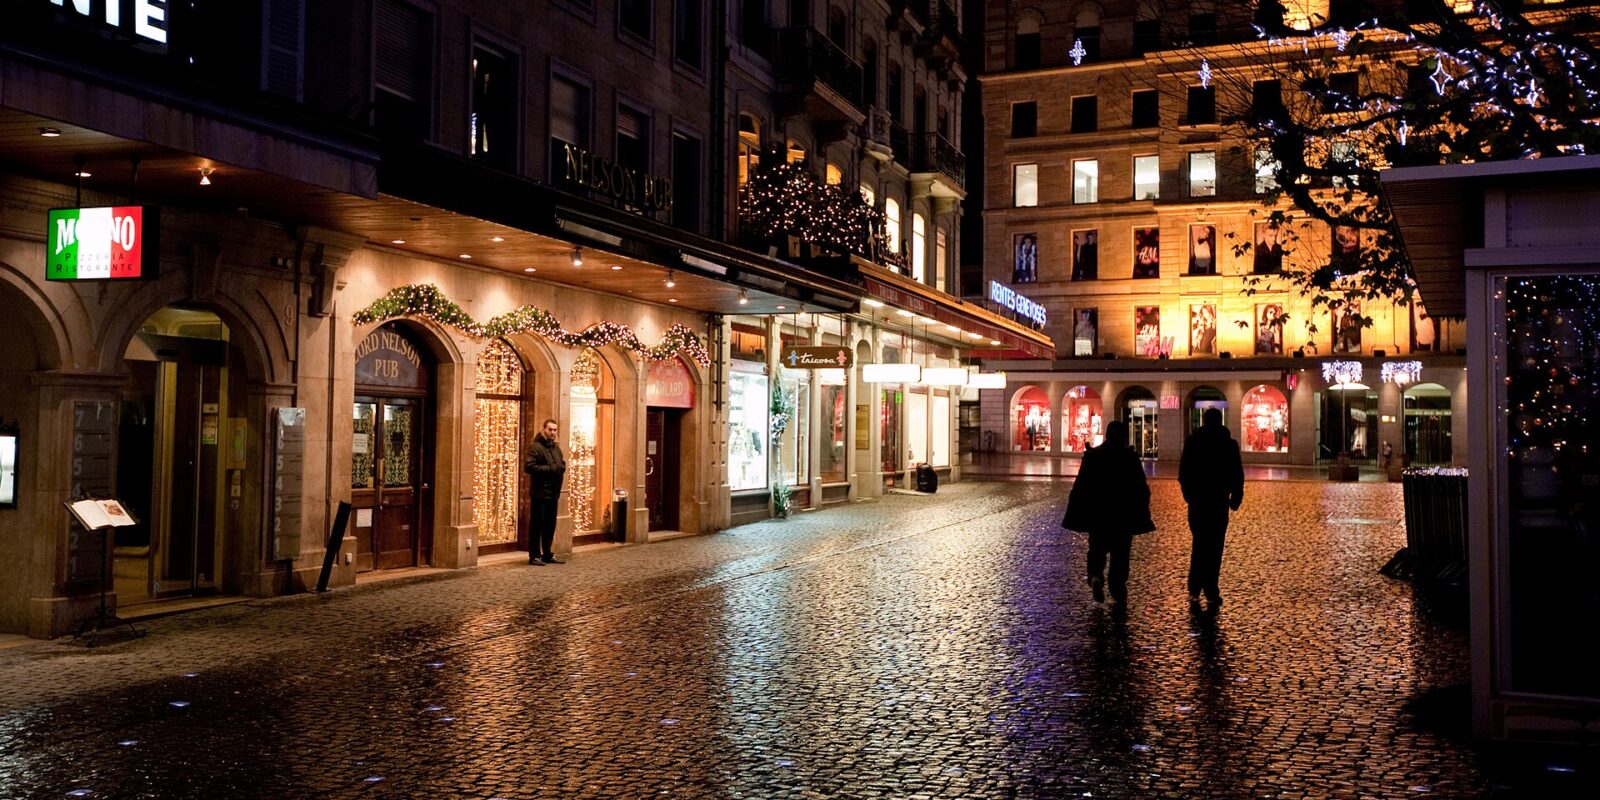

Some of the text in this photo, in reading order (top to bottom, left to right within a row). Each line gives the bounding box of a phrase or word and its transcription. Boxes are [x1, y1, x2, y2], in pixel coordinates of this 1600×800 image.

[50, 0, 167, 43] TE
[564, 144, 674, 210] NELSON PUB
[55, 216, 135, 255] MNO
[65, 253, 124, 262] PIZZERIA
[1138, 247, 1157, 260] H&M
[56, 264, 133, 272] RISTORANTE
[991, 280, 1016, 310] RENTES
[381, 332, 421, 369] NELSON
[374, 359, 399, 378] PUB
[75, 410, 84, 427] 7
[73, 458, 82, 476] 5
[277, 455, 284, 470] 5
